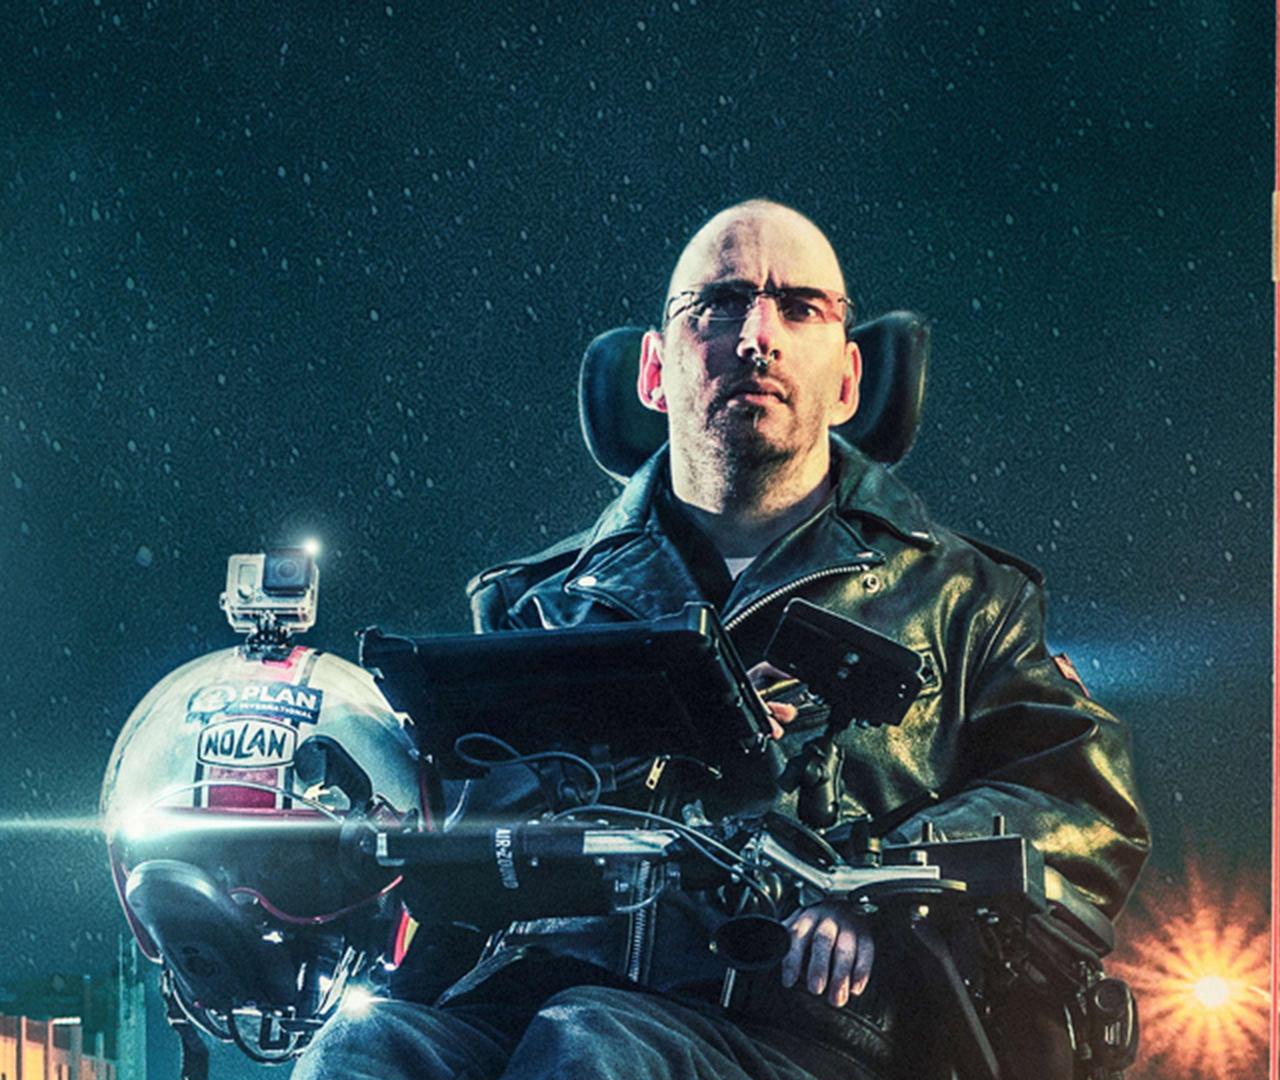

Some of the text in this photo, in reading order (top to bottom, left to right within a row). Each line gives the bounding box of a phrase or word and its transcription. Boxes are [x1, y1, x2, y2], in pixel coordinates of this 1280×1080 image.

[240, 685, 317, 710] PLAN
[239, 703, 314, 719] INTERNATIONAL
[204, 723, 287, 759] NOLAN
